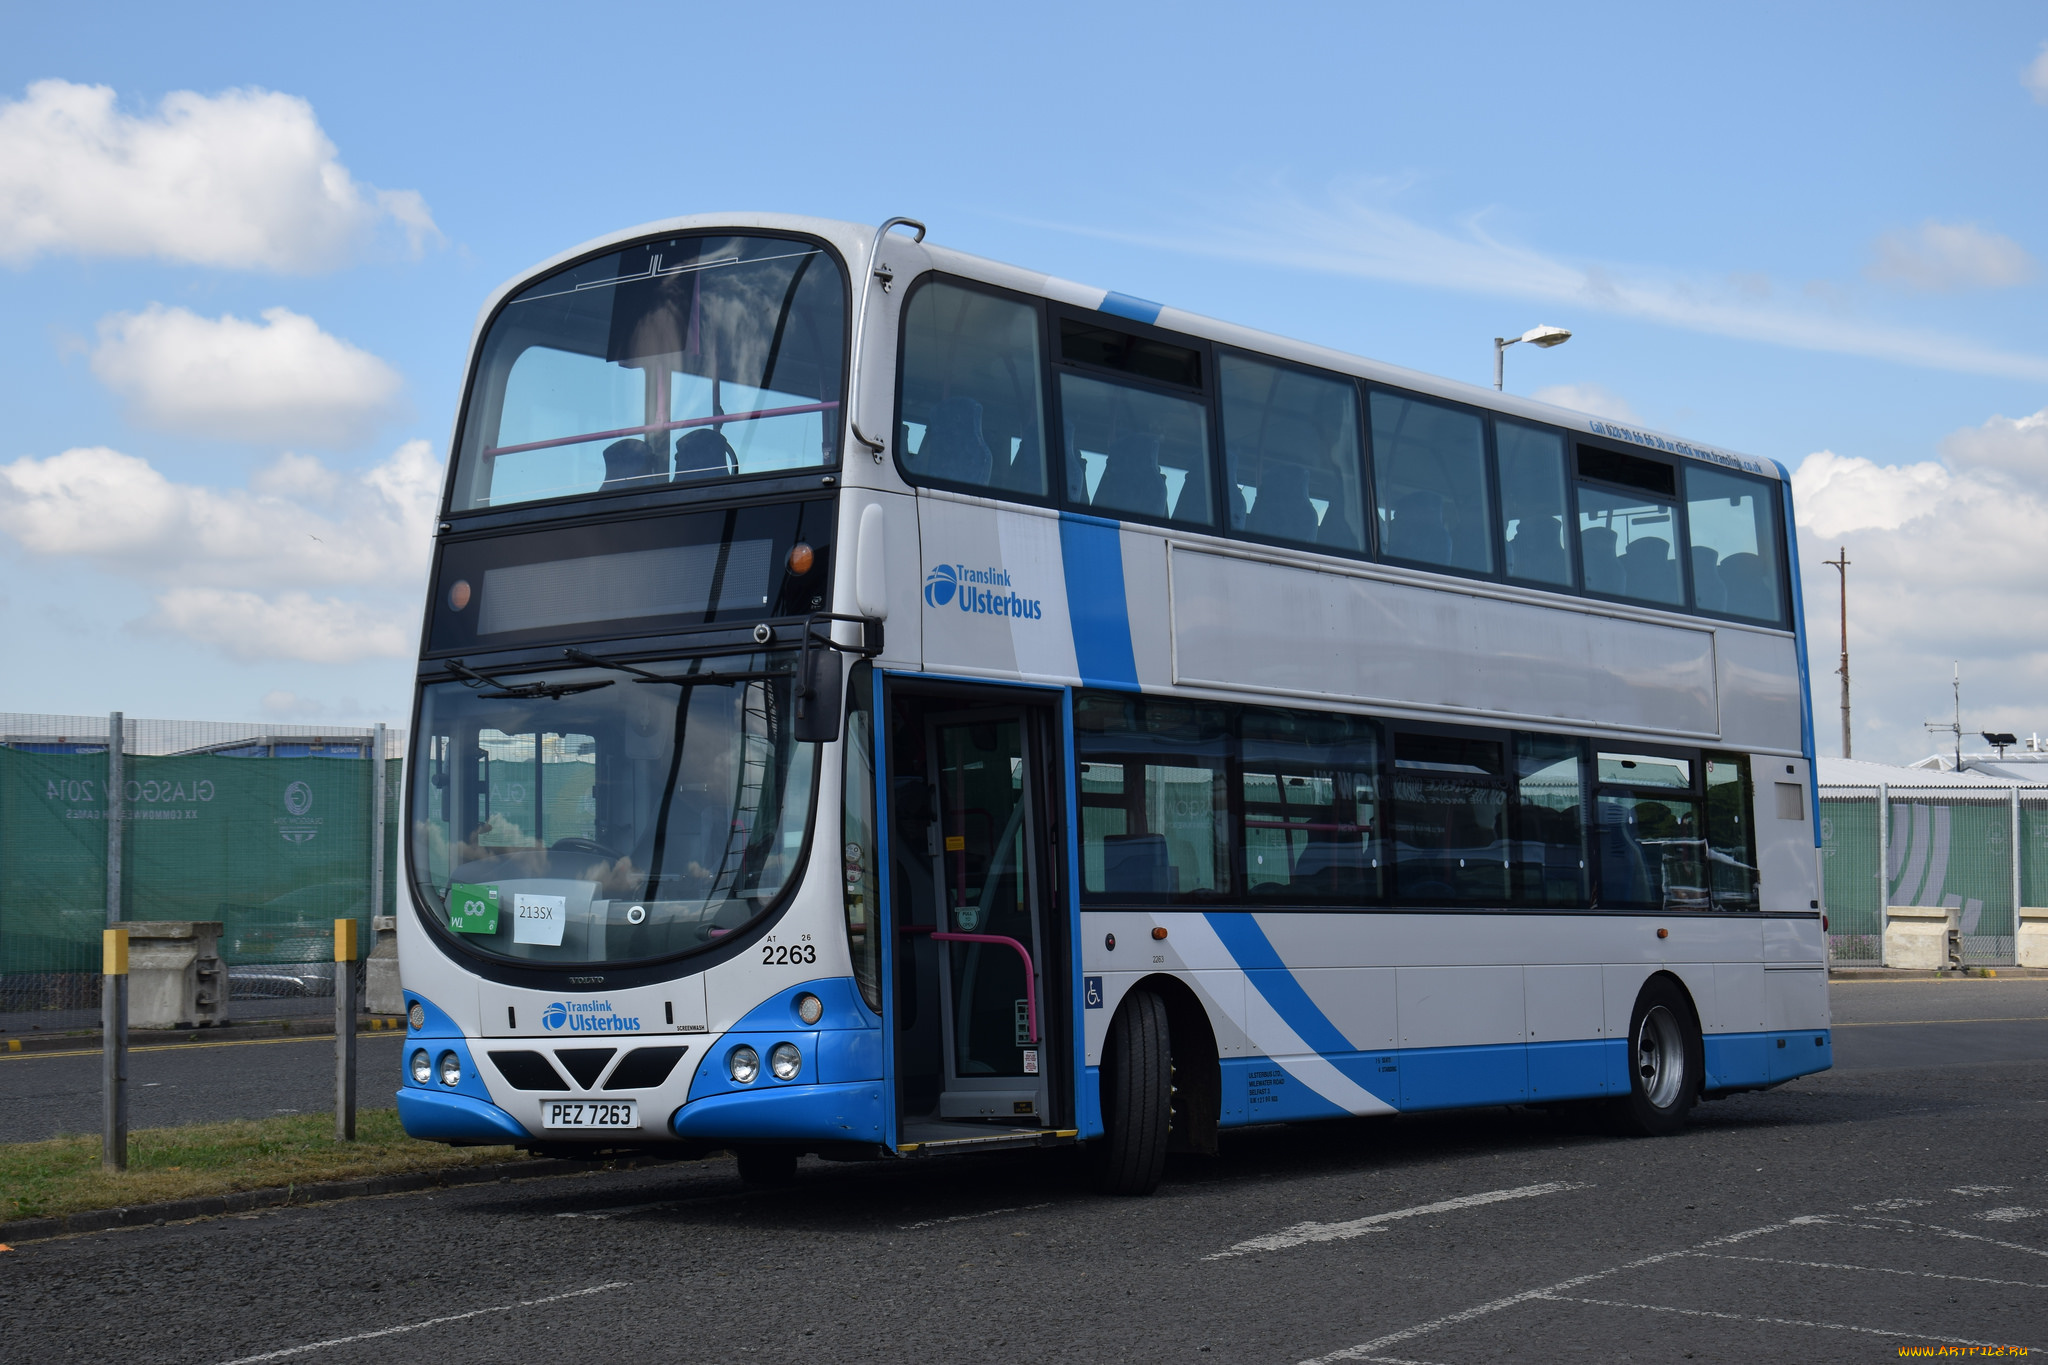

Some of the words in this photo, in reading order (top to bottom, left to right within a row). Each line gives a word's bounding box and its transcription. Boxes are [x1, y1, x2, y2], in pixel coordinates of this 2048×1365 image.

[1590, 420, 1606, 434] Call
[1606, 424, 1621, 438] 028
[1621, 428, 1632, 440] 90
[1633, 430, 1644, 444] 66
[1666, 441, 1675, 451] or
[957, 564, 1011, 587] Translink
[959, 585, 1041, 620] Ulsterbus
[519, 905, 553, 920] 213SX
[762, 944, 817, 965] 2263
[1152, 955, 1164, 964] 2263
[569, 976, 605, 984] VOLVO
[565, 1000, 612, 1012] Translink
[568, 1014, 640, 1031] Ulsterbus
[551, 1104, 584, 1125] PEZ
[588, 1104, 631, 1125] 7263
